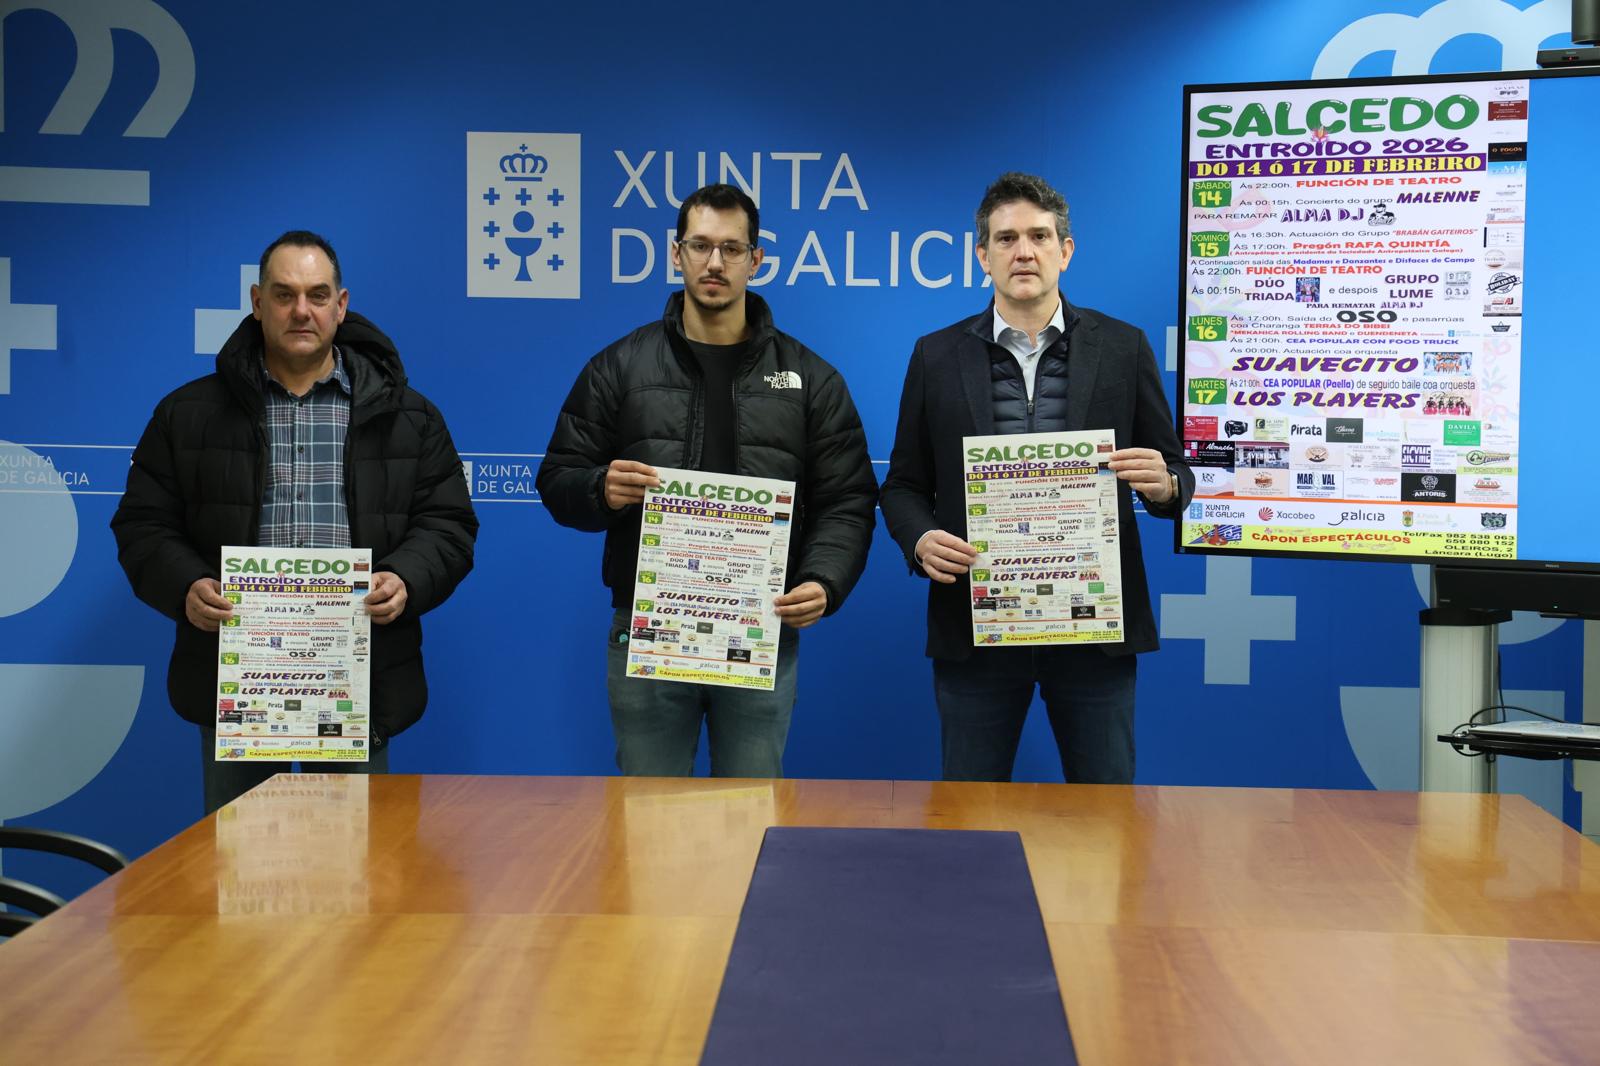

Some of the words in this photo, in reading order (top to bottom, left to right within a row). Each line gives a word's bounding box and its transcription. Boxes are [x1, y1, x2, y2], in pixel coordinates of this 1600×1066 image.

[1197, 94, 1479, 138] SALCEDO
[1382, 137, 1469, 155] 2026
[1196, 162, 1229, 177] DO
[1236, 161, 1262, 176] 14
[1269, 160, 1284, 175] Ó
[1291, 160, 1318, 175] 17
[1325, 159, 1355, 174] DE
[1363, 155, 1482, 173] FEBREIRO
[612, 150, 869, 211] XUNTA
[1297, 178, 1369, 188] FUNCIÓN
[1373, 178, 1395, 186] DE
[1400, 176, 1462, 185] TEATRO
[1198, 190, 1223, 206] 14
[1396, 190, 1480, 204] MALENNE
[1281, 208, 1332, 222] ALMA
[1191, 234, 1229, 242] DOMINGO
[1198, 242, 1219, 257] 15
[1293, 241, 1341, 250] Pregón
[1345, 241, 1384, 249] RAFA
[1388, 239, 1450, 248] QUINTÍA
[1246, 264, 1307, 275] FUNCIÓN
[1309, 266, 1327, 274] DE
[1331, 265, 1382, 275] TEATRO
[1255, 277, 1284, 288] DÚO
[1385, 274, 1439, 284] GRUPO
[1338, 285, 1378, 295] despois
[1390, 288, 1434, 298] LUME
[1245, 292, 1294, 301] TRIADA
[1191, 316, 1223, 326] LUNES
[1336, 310, 1398, 323] OSO
[1196, 325, 1218, 340] 16
[1231, 357, 1419, 373] SUAVECITO
[1191, 380, 1225, 389] MARTES
[1263, 379, 1280, 387] CEA
[1282, 379, 1321, 388] POPULAR
[1323, 379, 1354, 390] (Paella)
[1356, 380, 1367, 388] de
[1369, 380, 1400, 391] seguido
[1402, 380, 1421, 389] baile
[1440, 382, 1475, 392] orquesta
[1195, 389, 1218, 404] 17
[1233, 391, 1286, 406] LOS
[1293, 391, 1420, 409] PLAYERS
[1291, 424, 1322, 436] Pirata
[967, 442, 1094, 463] SALCEDO
[1053, 459, 1090, 468] 2026
[478, 465, 532, 477] XUNTA
[968, 472, 983, 481] DO
[1013, 471, 1024, 479] 17
[1028, 469, 1041, 477] DE
[1044, 467, 1096, 477] FEBREIRO
[24, 471, 90, 486] GALICIA
[1296, 473, 1313, 484] MAR
[1322, 473, 1335, 485] VAL
[478, 481, 497, 493] DE
[649, 480, 773, 505] SALCEDO
[647, 503, 662, 512] DO
[665, 505, 678, 513] 14
[690, 507, 701, 515] 17
[705, 509, 718, 517] DE
[721, 510, 773, 523] FEBREIRO
[731, 504, 767, 514] 2026
[1276, 510, 1315, 520] Xacobeo
[1334, 509, 1385, 524] galicia
[1037, 535, 1065, 543] OSO
[1252, 532, 1297, 543] CAPON
[1302, 532, 1411, 544] ESPECTÁCULOS
[225, 557, 350, 575] SALCEDO
[991, 555, 1076, 566] SUAVECITO
[309, 577, 346, 585] 2026
[705, 575, 732, 584] OSO
[993, 573, 1014, 582] LOS
[1020, 571, 1077, 581] PLAYERS
[225, 584, 240, 592] DO
[243, 584, 255, 592] 14
[269, 584, 280, 592] 17
[301, 585, 351, 593] FEBREIRO
[656, 591, 740, 606] SUAVECITO
[656, 606, 678, 615] LOS
[683, 609, 738, 621] PLAYERS
[241, 672, 326, 680] SUAVECITO
[269, 688, 326, 696] PLAYERS
